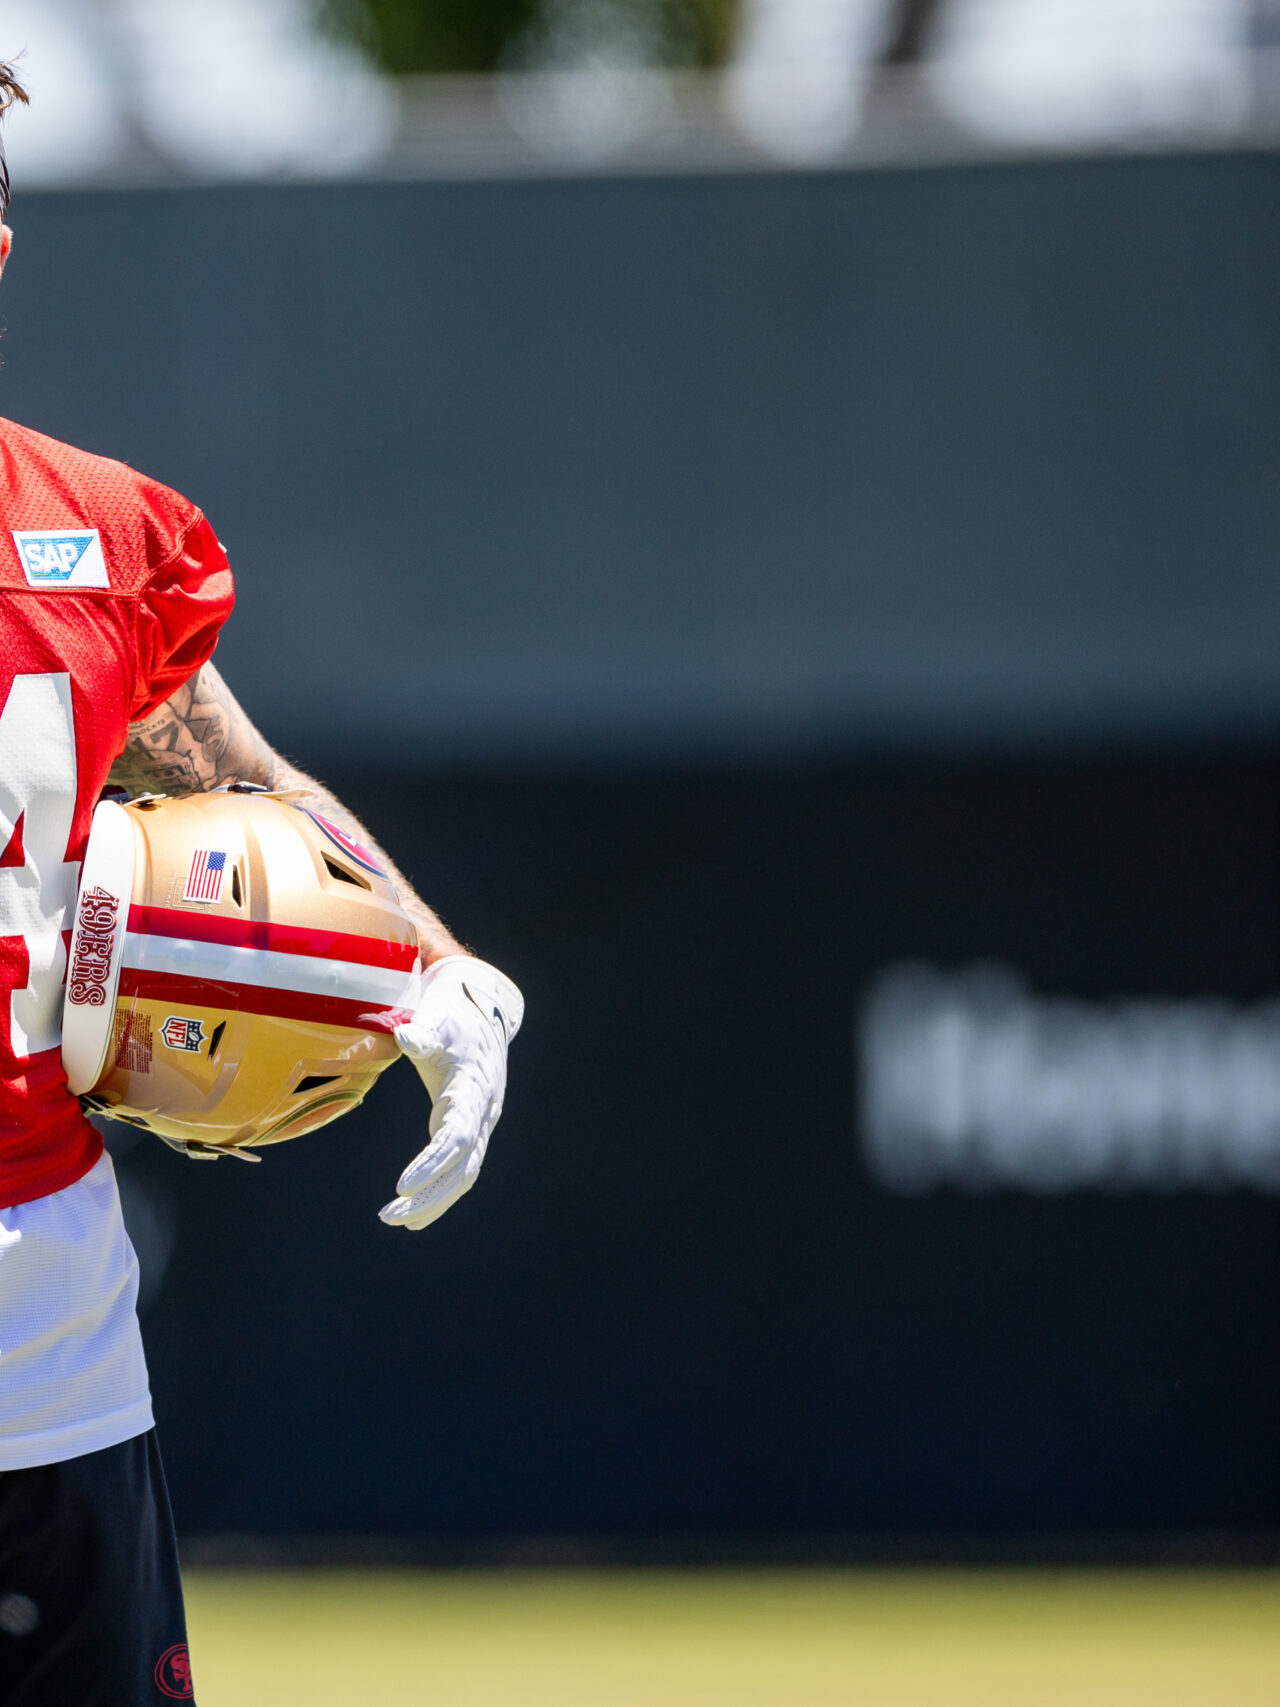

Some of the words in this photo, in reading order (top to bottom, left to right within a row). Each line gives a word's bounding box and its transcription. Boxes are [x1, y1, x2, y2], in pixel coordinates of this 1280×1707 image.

[25, 543, 78, 572] SAP
[68, 885, 120, 1006] 49ERS
[166, 1020, 187, 1046] NFL
